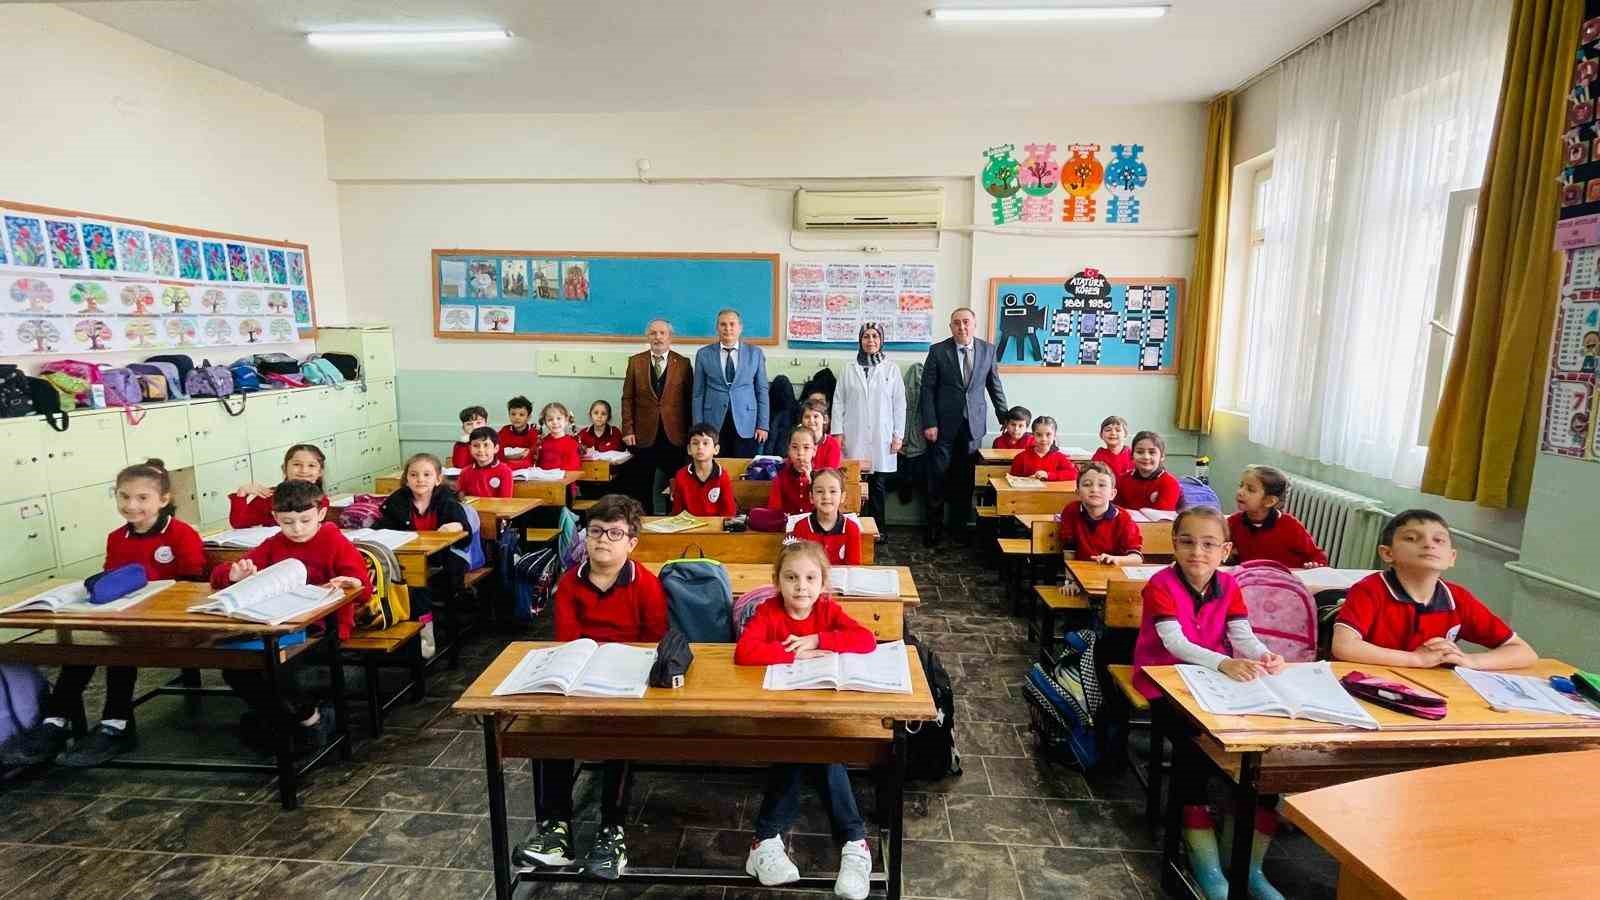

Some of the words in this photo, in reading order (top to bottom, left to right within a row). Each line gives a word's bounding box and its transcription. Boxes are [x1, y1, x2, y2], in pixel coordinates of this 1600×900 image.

[1070, 277, 1104, 287] ATATÜRK
[1587, 309, 1598, 327] 4
[1574, 392, 1585, 409] 7
